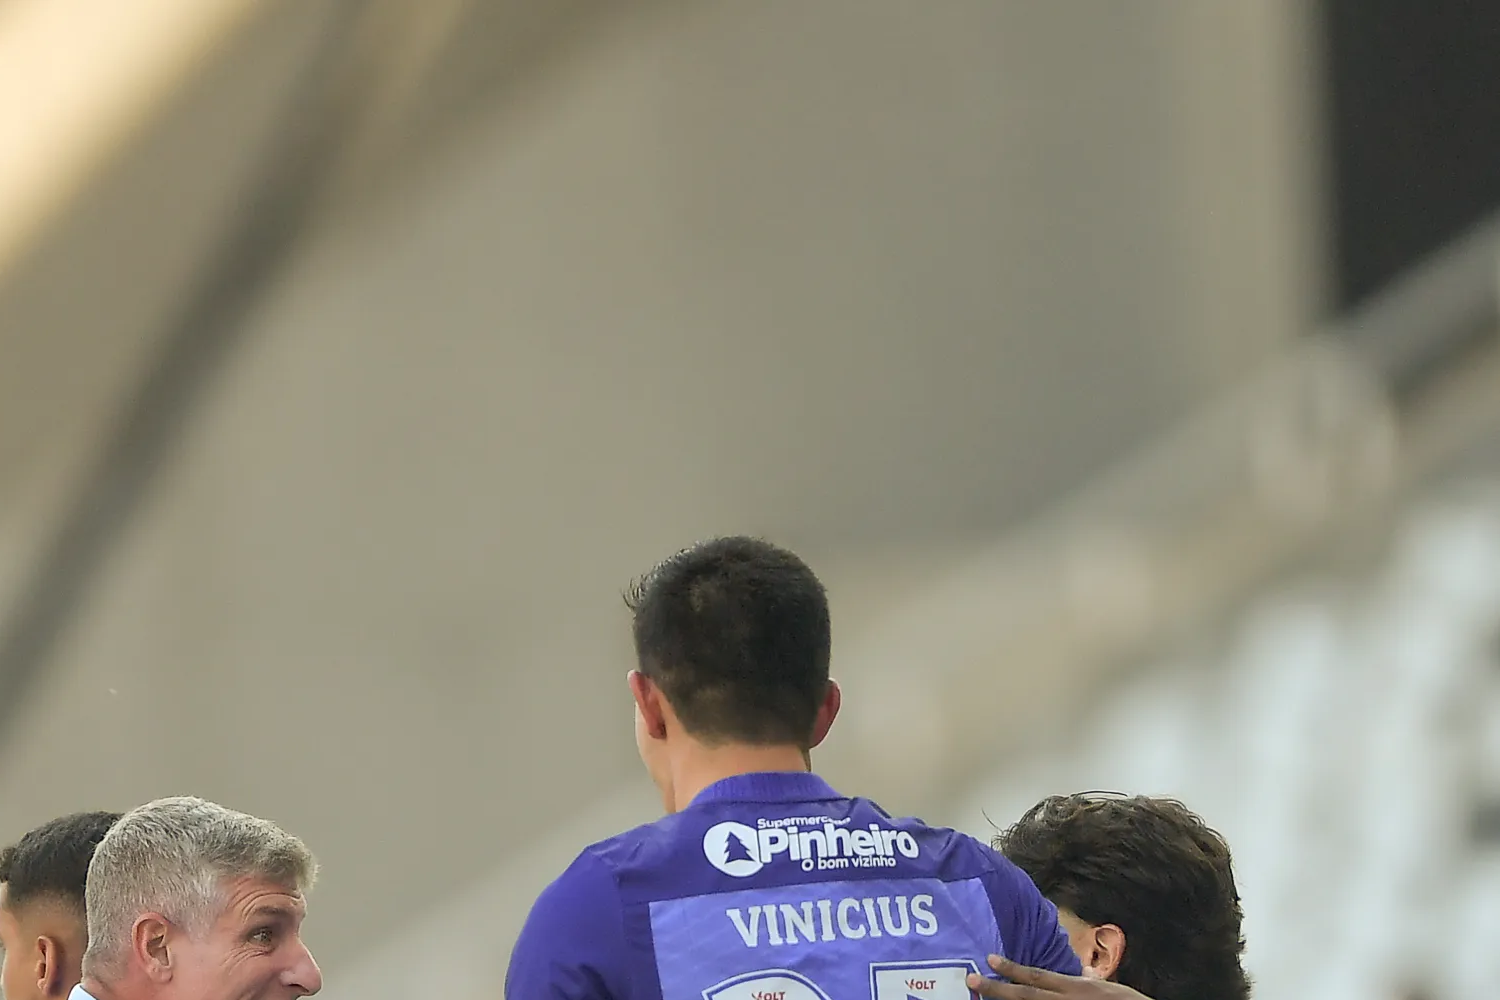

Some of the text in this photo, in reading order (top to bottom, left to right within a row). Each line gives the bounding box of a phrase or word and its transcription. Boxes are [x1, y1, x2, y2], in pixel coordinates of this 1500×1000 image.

[757, 823, 920, 864] Pinheiro
[802, 853, 897, 872] O bom vizinho
[725, 894, 939, 947] VINICIUS
[904, 978, 937, 991] VOLT
